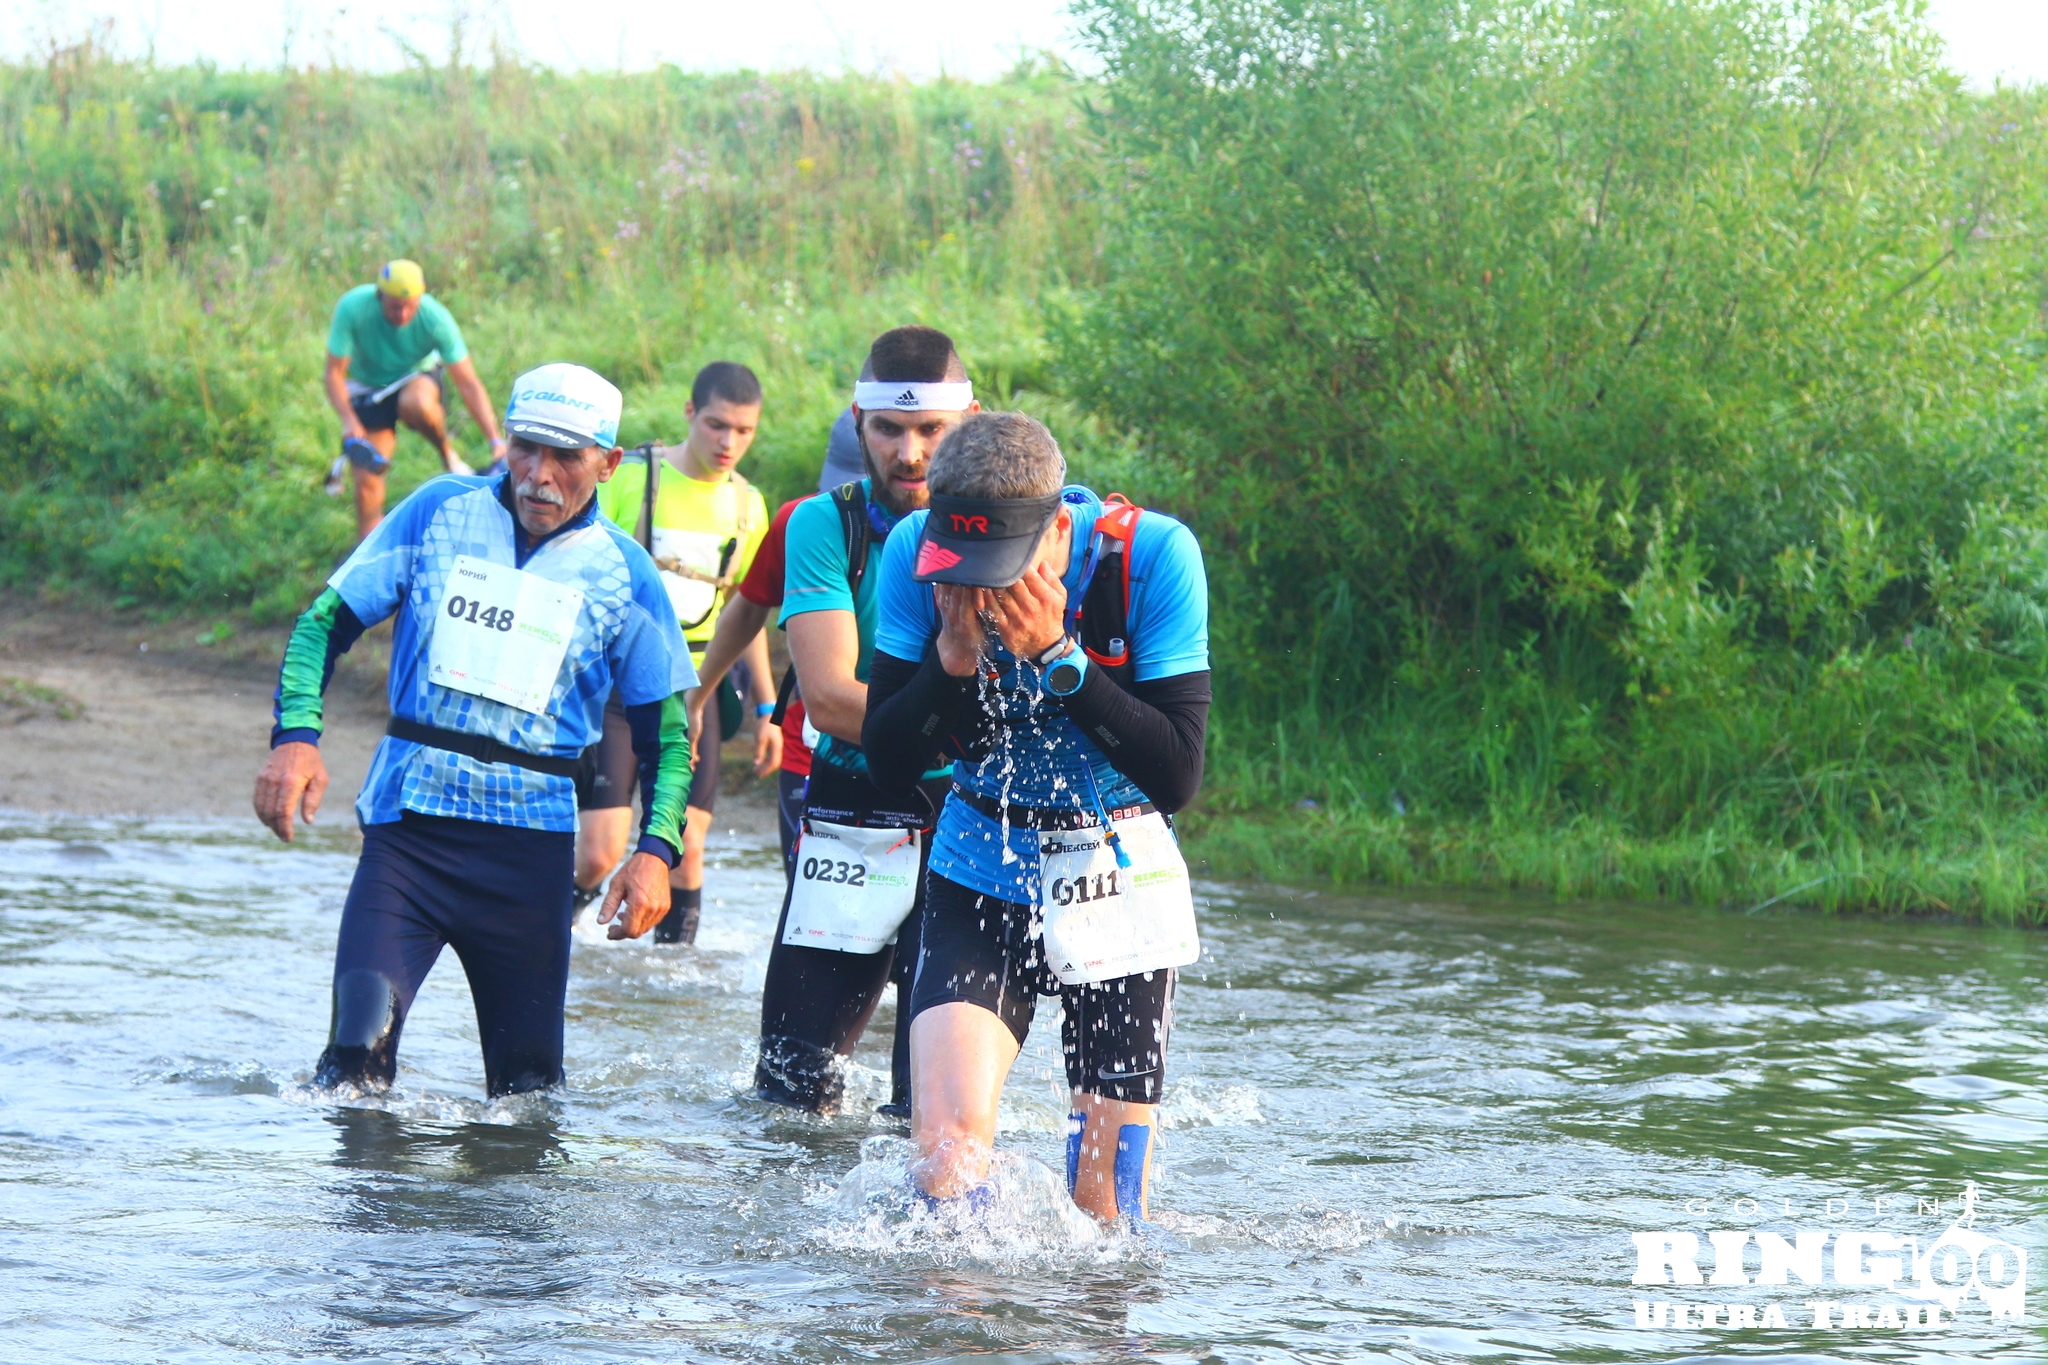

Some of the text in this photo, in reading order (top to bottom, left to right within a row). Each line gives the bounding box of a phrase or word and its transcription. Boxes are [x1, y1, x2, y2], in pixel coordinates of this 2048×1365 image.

[534, 391, 595, 411] GIANT
[526, 426, 579, 445] GIANT
[950, 514, 989, 533] TYR
[458, 568, 488, 582] ЮРИЙ
[447, 595, 515, 632] 0148
[449, 669, 468, 679] GNC
[807, 806, 854, 817] performance
[812, 812, 841, 820] recovery
[886, 816, 924, 825] anti-shock
[803, 857, 866, 887] 0232
[1052, 870, 1122, 906] 0111
[831, 932, 854, 940] MOSCOW
